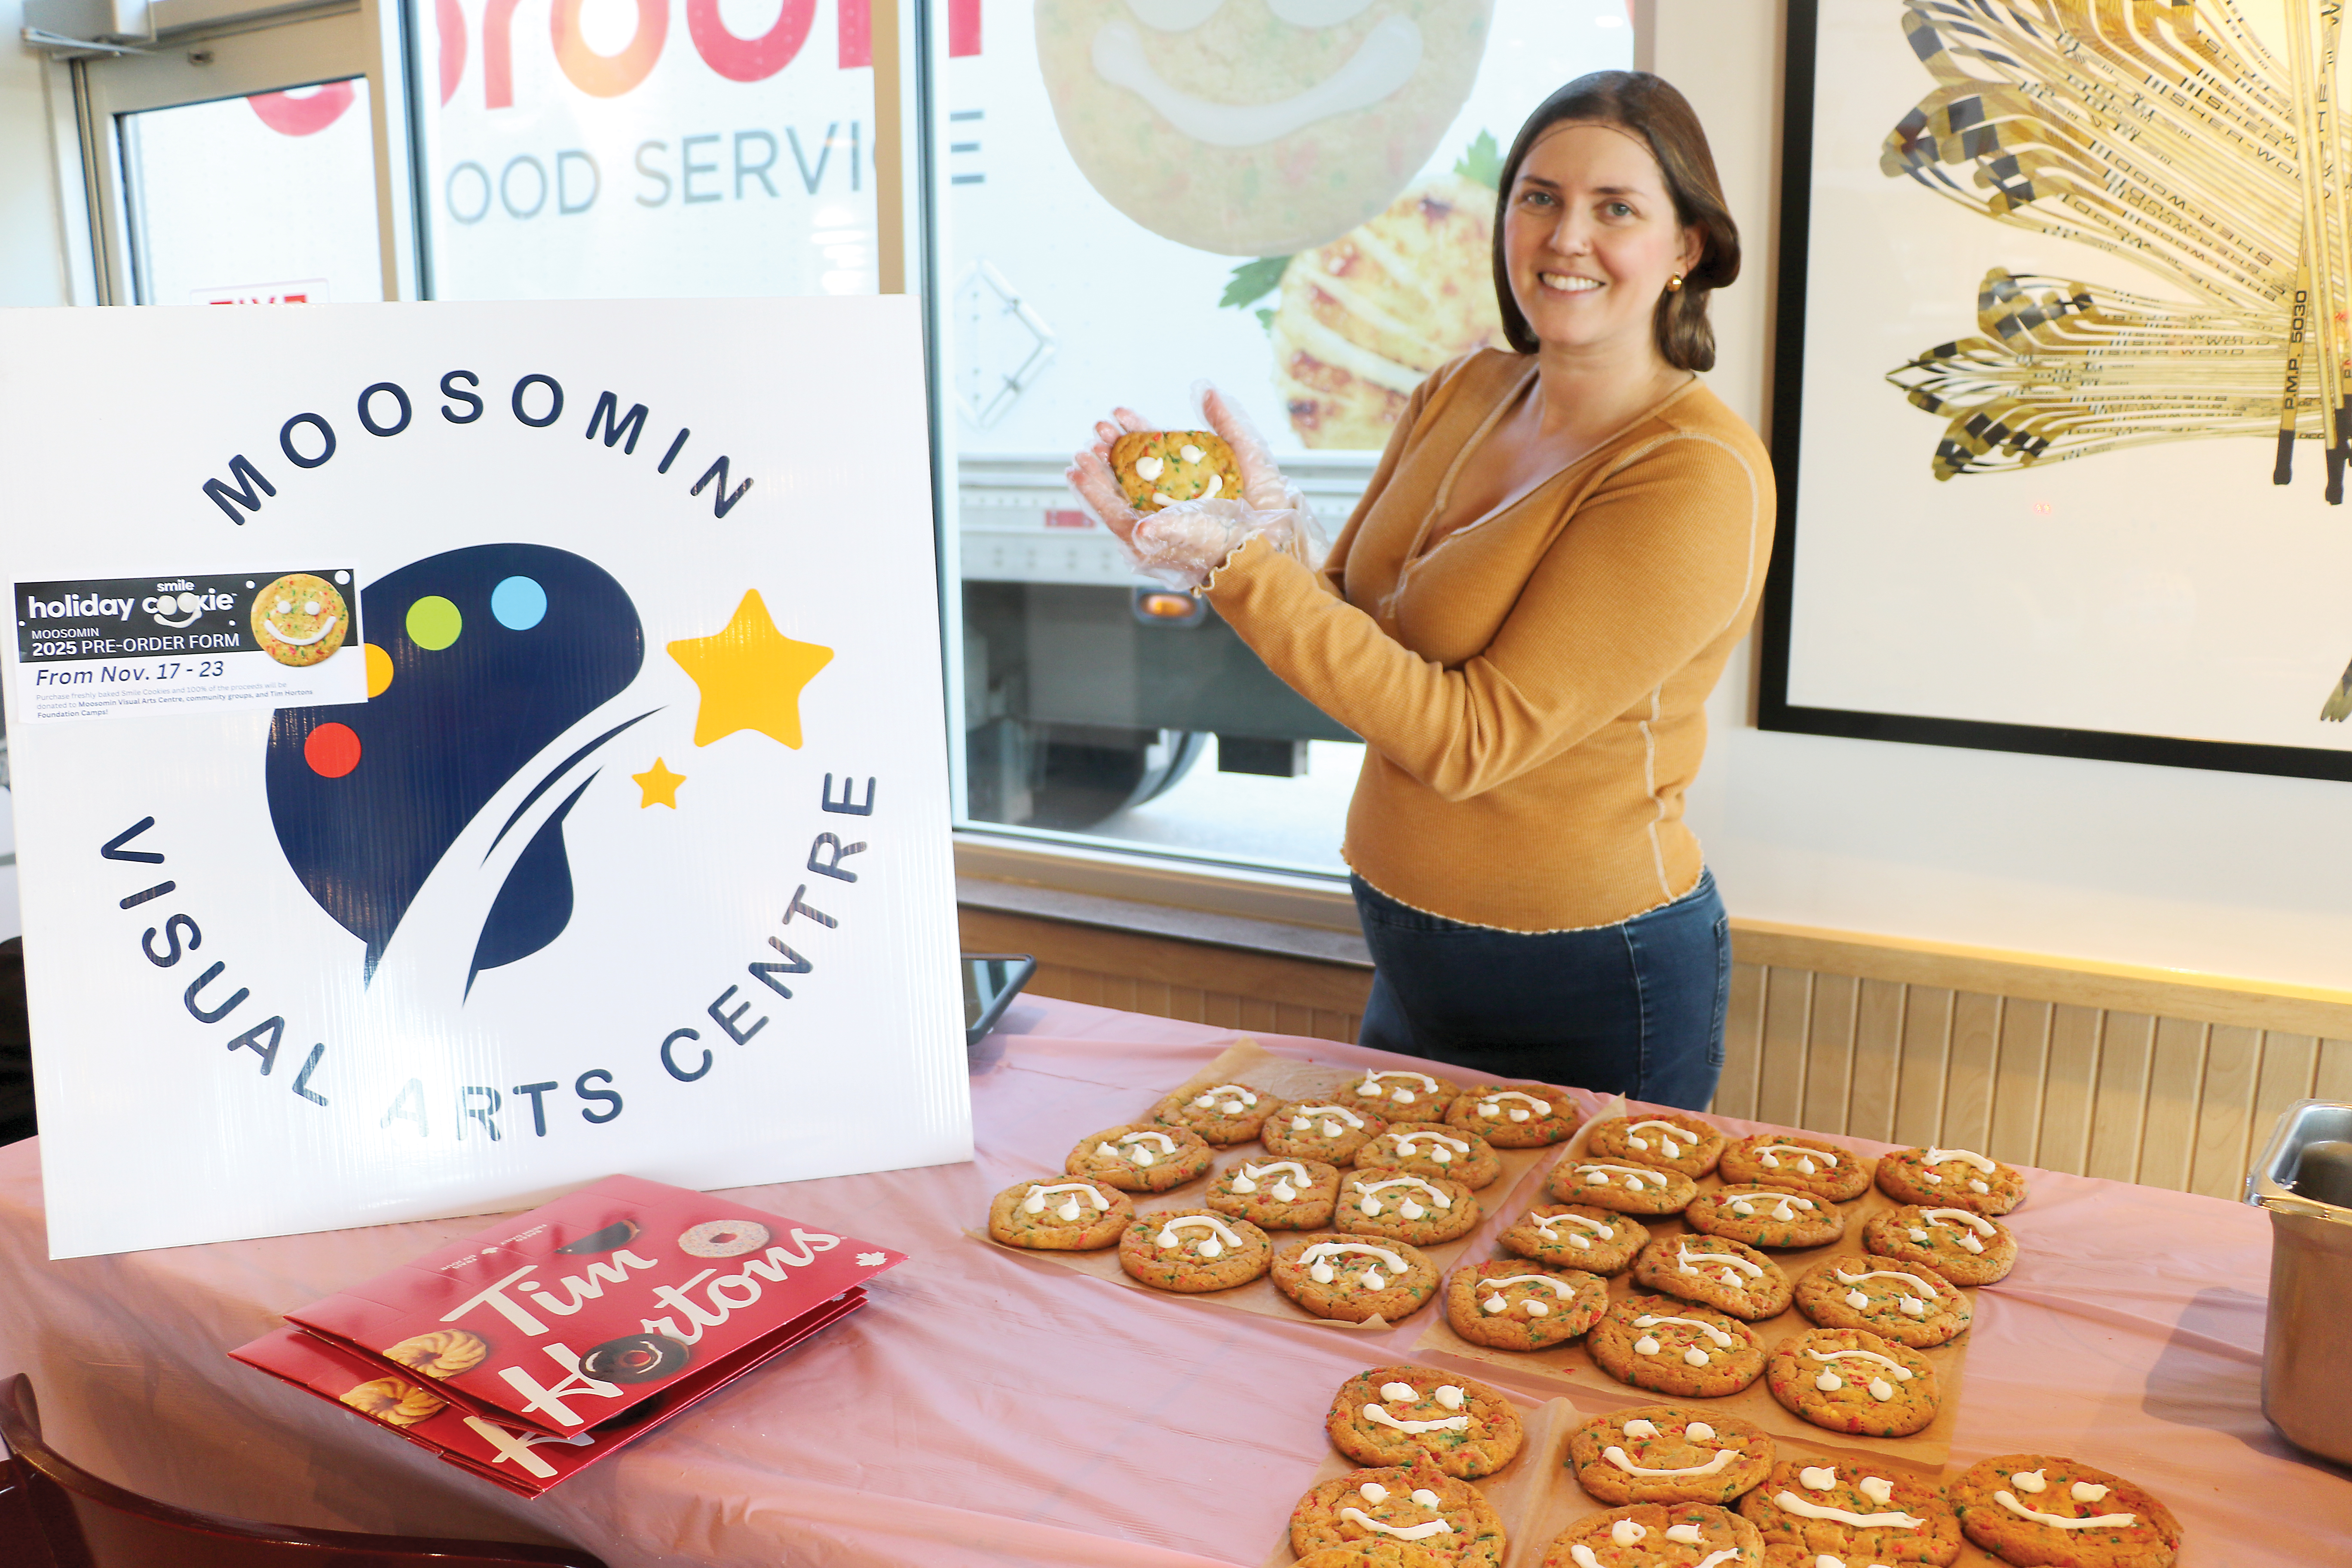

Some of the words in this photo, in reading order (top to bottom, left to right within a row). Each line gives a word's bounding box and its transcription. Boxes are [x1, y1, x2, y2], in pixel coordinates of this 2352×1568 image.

[445, 148, 602, 225] OOD
[634, 109, 985, 209] SERVIE
[2114, 156, 2273, 267] SHER-WOOD
[2291, 290, 2307, 343] 5030
[2285, 353, 2300, 409] P.M.P.
[202, 370, 754, 526] MOOSOMIN
[28, 593, 135, 621] holiday
[157, 579, 195, 592] smile
[31, 628, 99, 639] MOOSOMIN
[32, 641, 77, 656] 2025
[81, 636, 185, 654] PRE-ORDER
[189, 633, 240, 649] FORM
[36, 669, 93, 686] From
[101, 666, 150, 683] Nov.
[157, 663, 181, 680] 17
[199, 661, 224, 677] 23
[79, 699, 116, 707] Moosomin
[186, 693, 225, 702] community
[101, 816, 331, 1106] VISUAL
[379, 1069, 623, 1142] ARTS
[660, 772, 876, 1082] CENTRE
[439, 1249, 658, 1336] Tim
